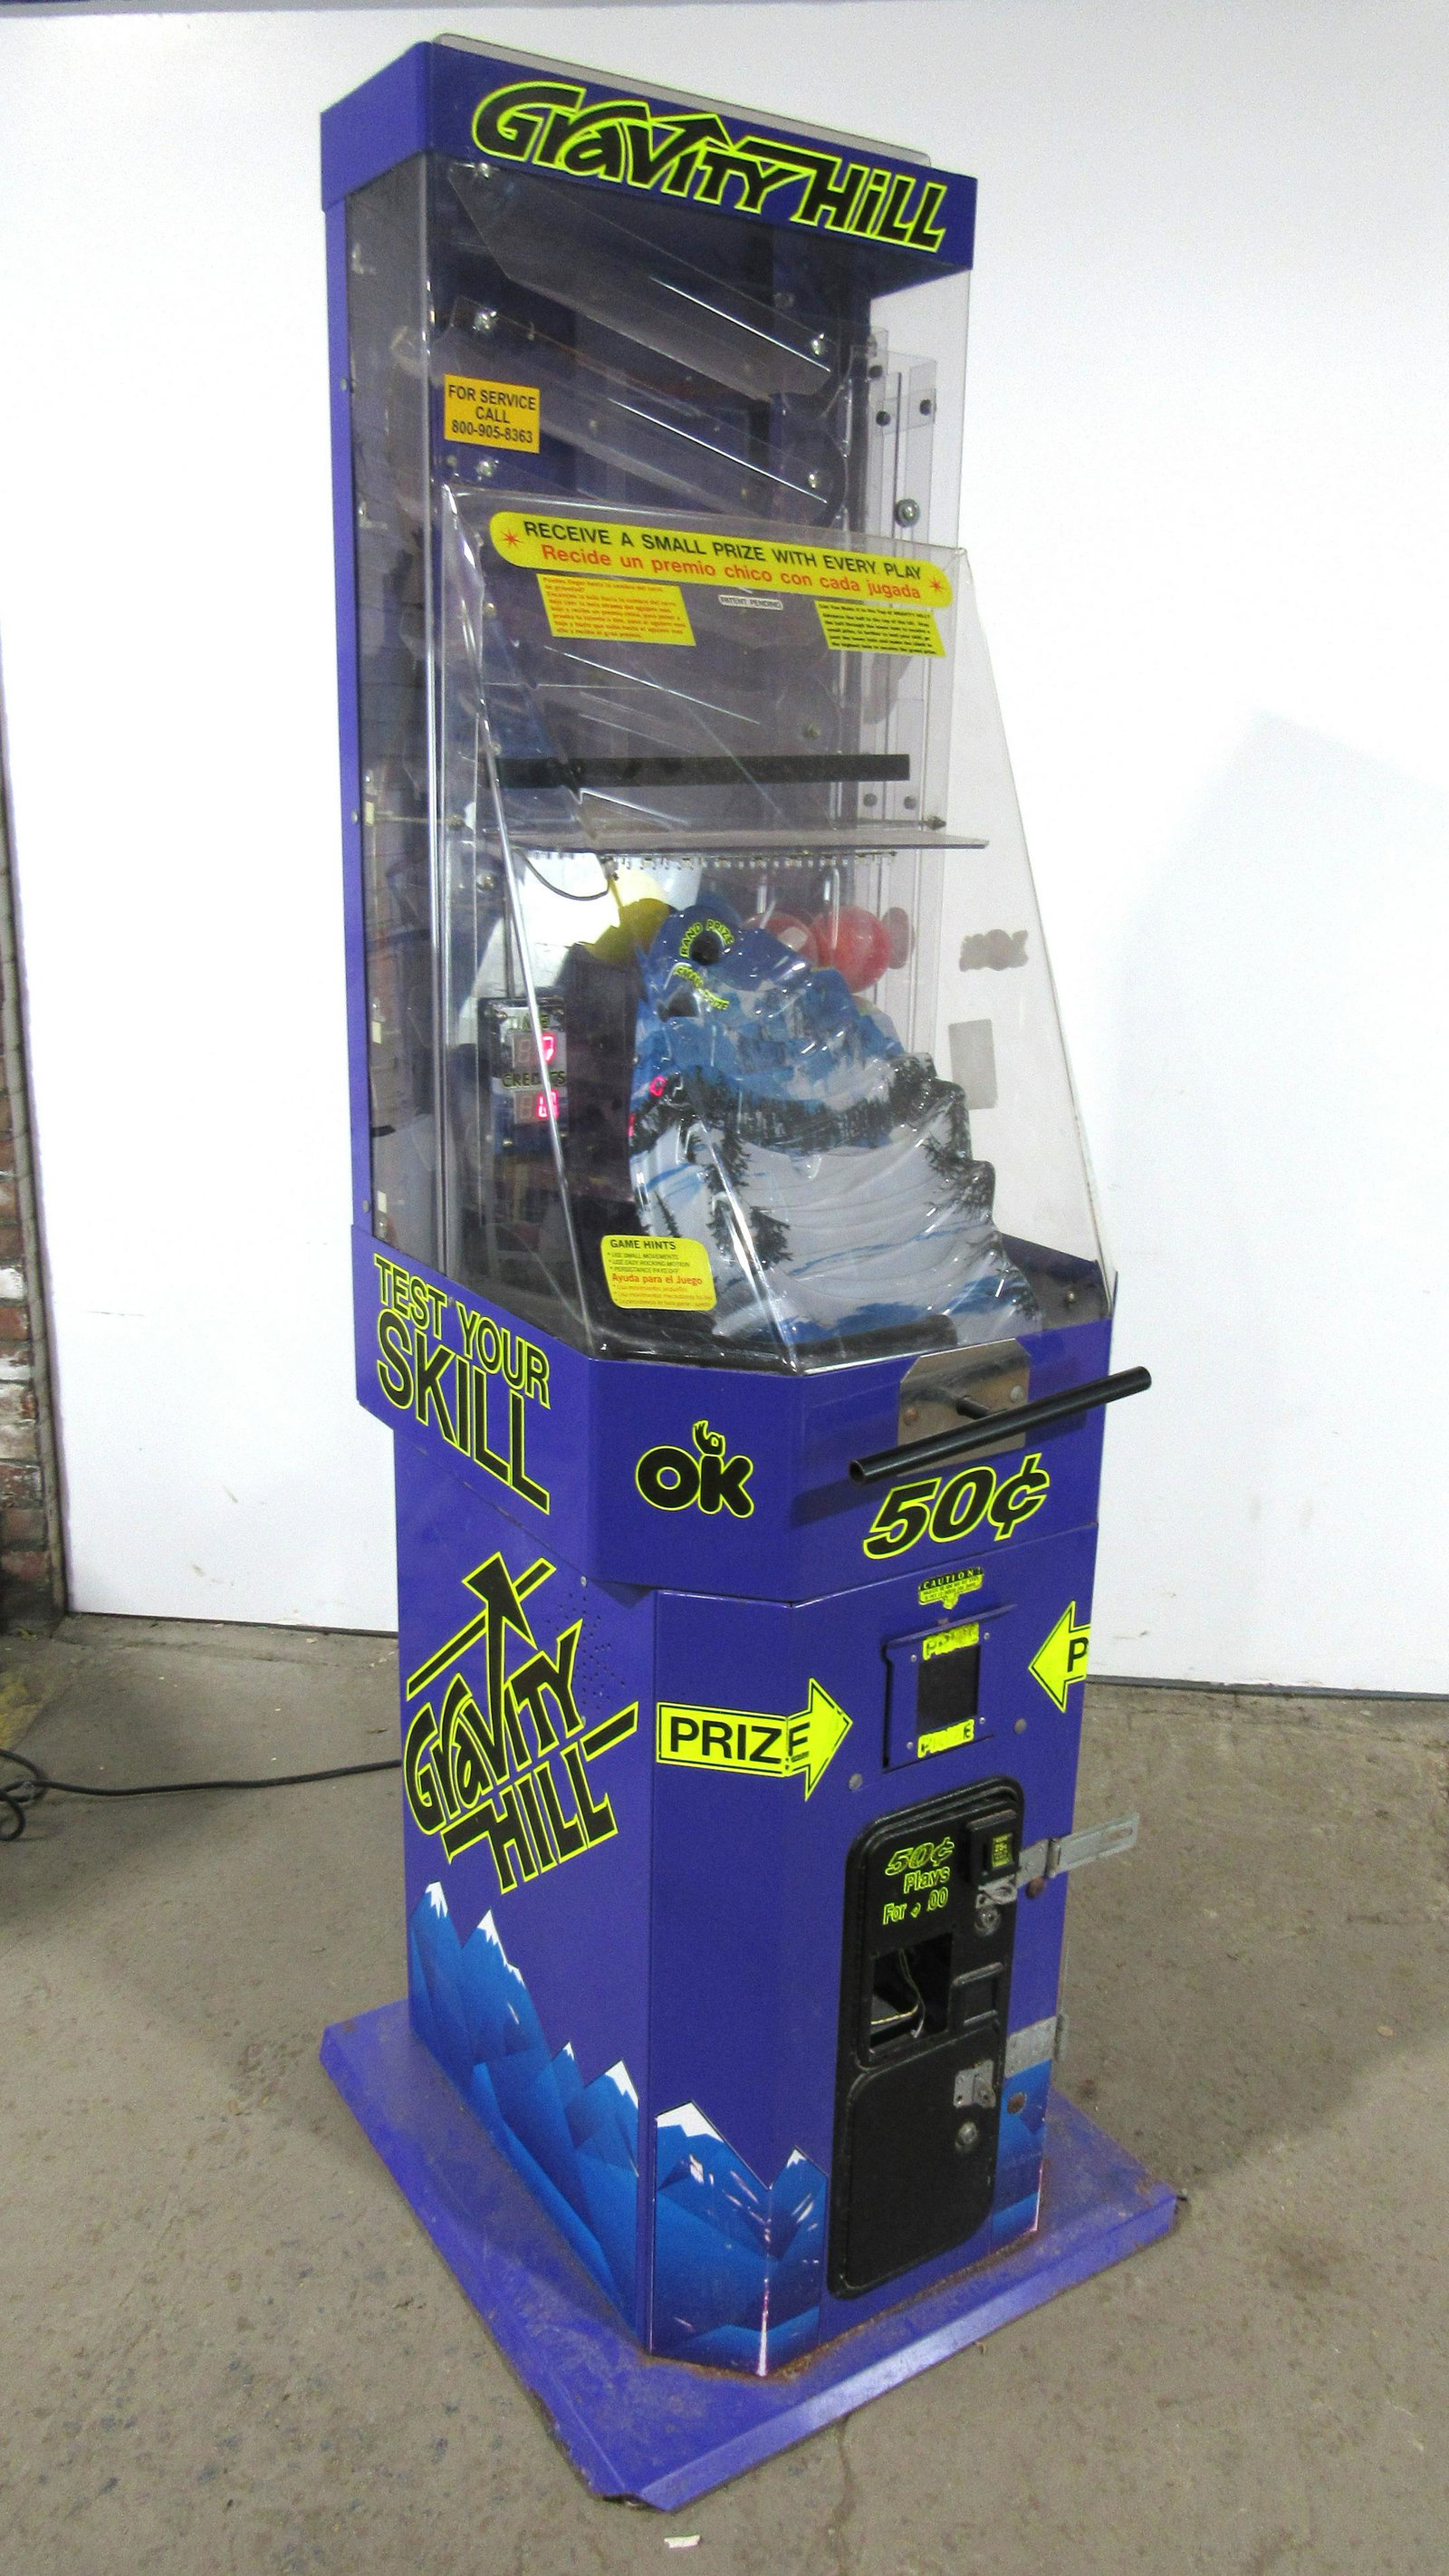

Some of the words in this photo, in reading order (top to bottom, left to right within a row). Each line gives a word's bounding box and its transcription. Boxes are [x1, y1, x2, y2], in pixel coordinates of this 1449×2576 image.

[448, 384, 476, 401] FOR
[480, 389, 537, 410] SERVICE
[475, 406, 511, 424] CALL
[451, 419, 533, 443] 800-905-8363
[523, 521, 612, 544] RECEIVE
[621, 532, 635, 547] A
[642, 534, 707, 555] SMALL
[713, 541, 767, 562] PRIZE
[771, 549, 818, 568] WITH
[823, 555, 878, 574] EVERY
[883, 562, 922, 581] PLAY
[541, 543, 612, 566] Recide
[620, 556, 644, 569] un
[651, 558, 716, 577] premio
[724, 564, 772, 583] chico
[781, 572, 813, 587] con
[820, 576, 861, 591] cada
[867, 580, 922, 600] jugada
[609, 1239, 641, 1249] GAME
[643, 1240, 677, 1250] HINTS
[611, 1273, 639, 1283] Ayuda
[643, 1275, 663, 1284] para
[666, 1275, 674, 1283] el
[677, 1276, 703, 1287] Juego
[373, 1253, 448, 1341] TEST
[456, 1301, 552, 1410] YOUR
[377, 1308, 551, 1516] SKILL
[636, 1419, 755, 1519] OK
[863, 1452, 1051, 1560] 50¢
[669, 1716, 811, 1764] PRIZE
[441, 1742, 619, 1895] HILL
[885, 1836, 955, 1876] 50¢
[903, 1866, 951, 1894] Plays
[883, 1902, 907, 1926] For
